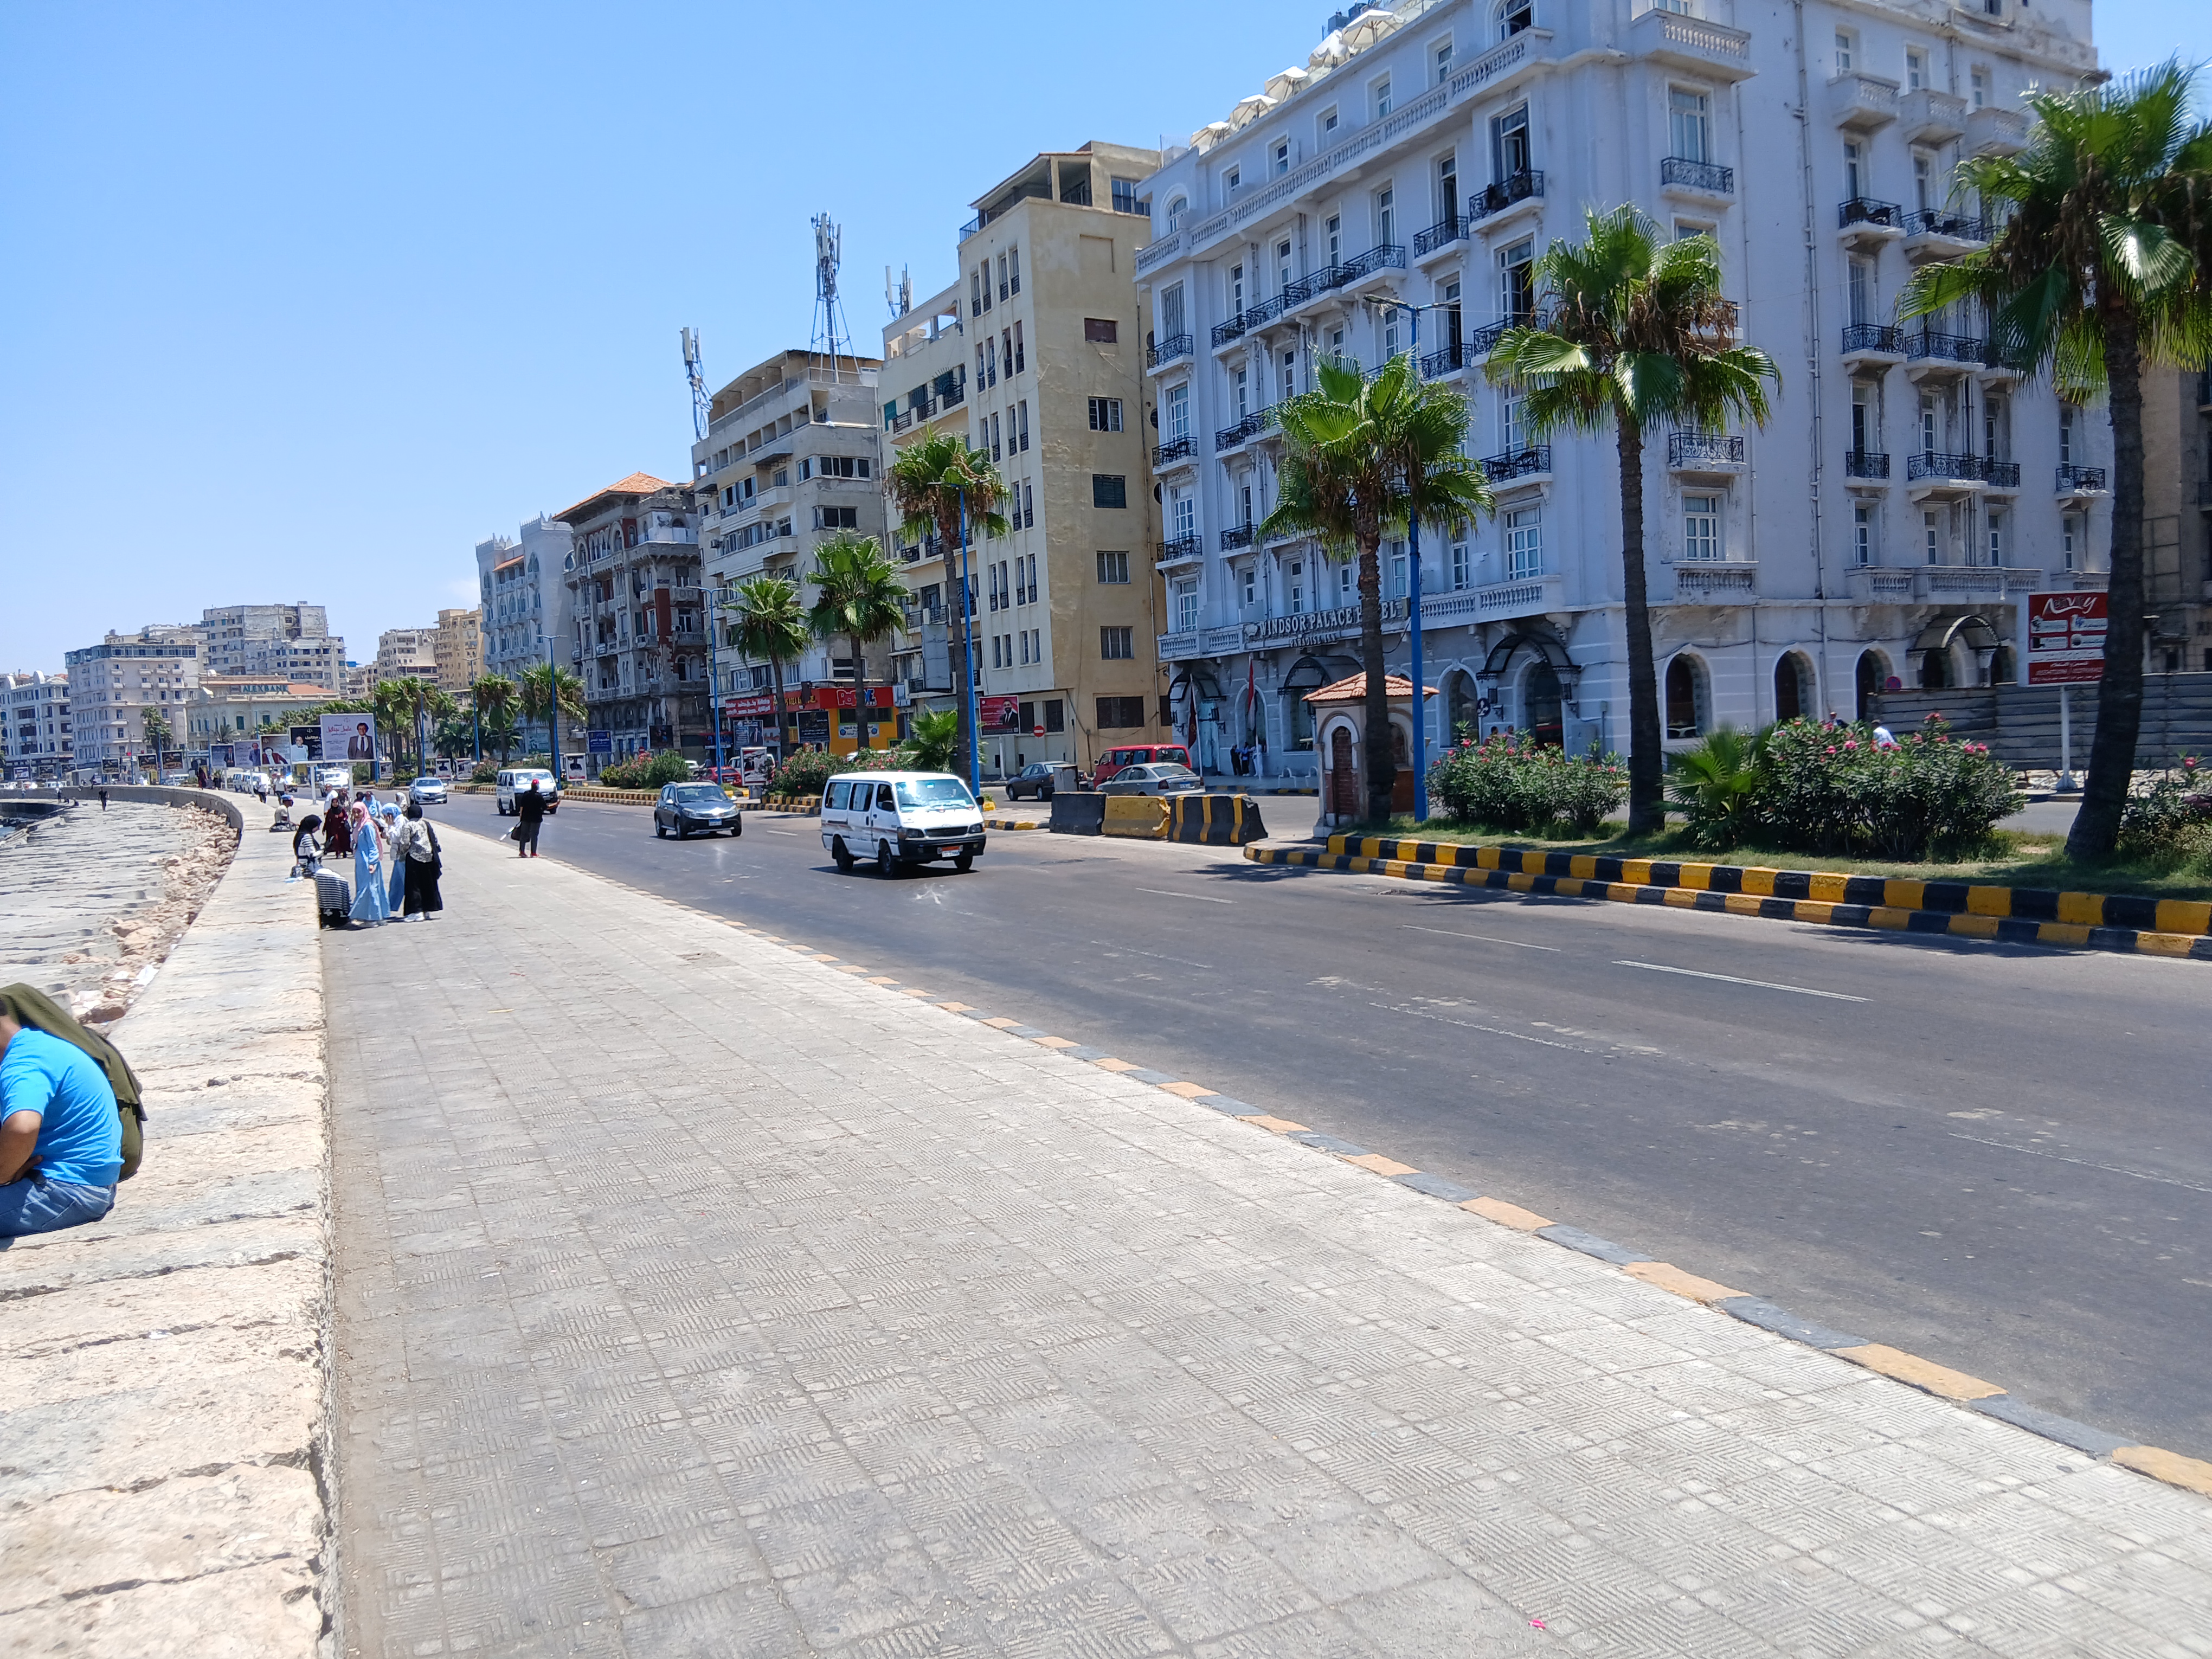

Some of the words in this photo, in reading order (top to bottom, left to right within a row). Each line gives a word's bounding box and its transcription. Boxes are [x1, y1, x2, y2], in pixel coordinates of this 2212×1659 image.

[1259, 614, 1307, 637] WINDSOR
[1309, 608, 1353, 630] PALACE
[1355, 600, 1397, 623] HEL
[1289, 635, 1321, 648] PARADISE
[243, 684, 288, 692] ALEXBANK
